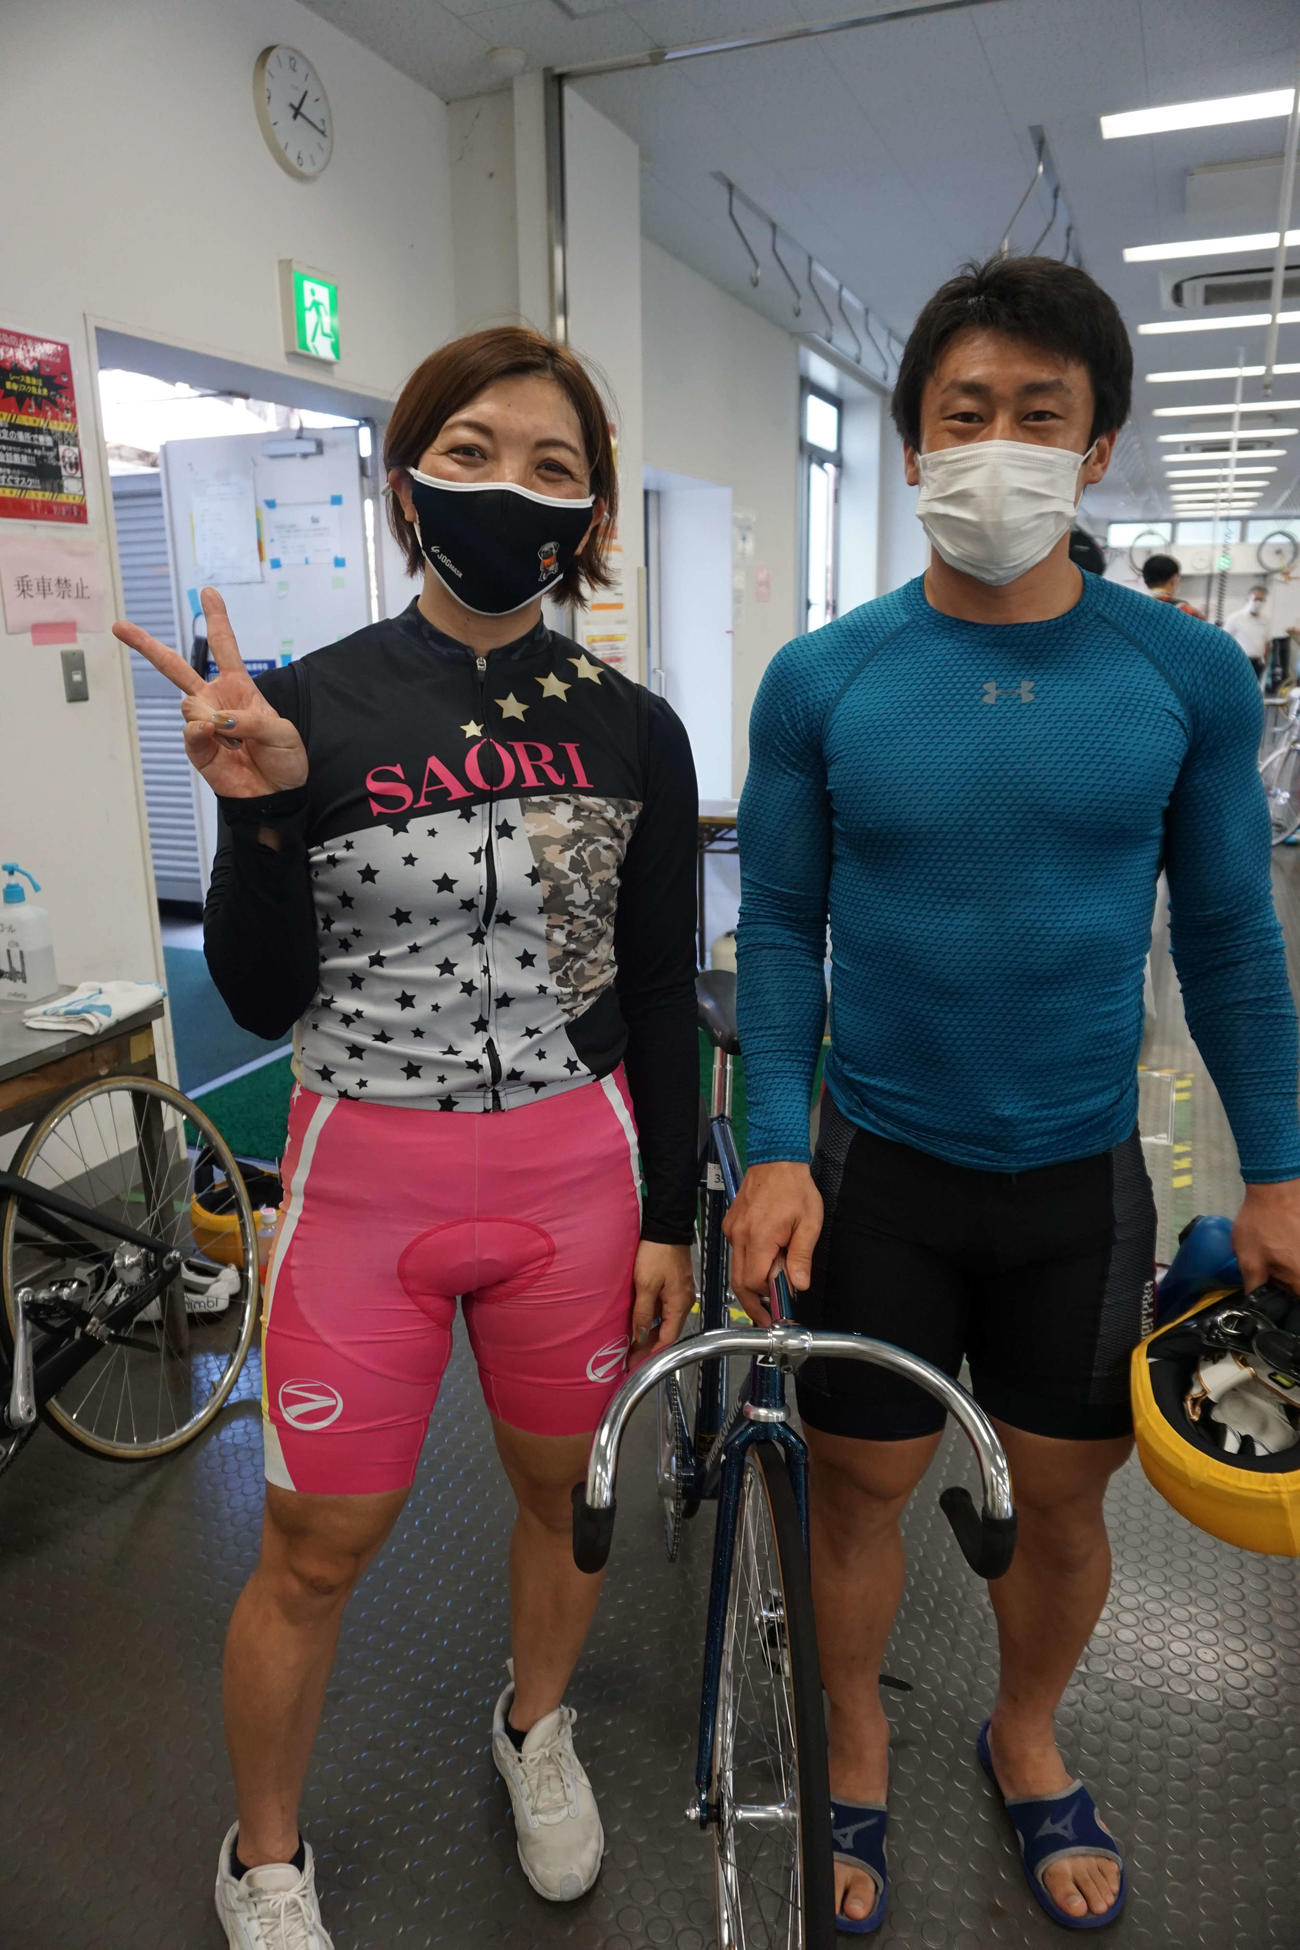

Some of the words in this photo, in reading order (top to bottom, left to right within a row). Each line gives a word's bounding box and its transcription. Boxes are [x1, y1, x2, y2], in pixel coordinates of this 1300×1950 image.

[288, 56, 297, 73] 12
[296, 150, 304, 167] 6
[15, 574, 91, 600] 乗車禁止
[365, 738, 594, 817] SAORI
